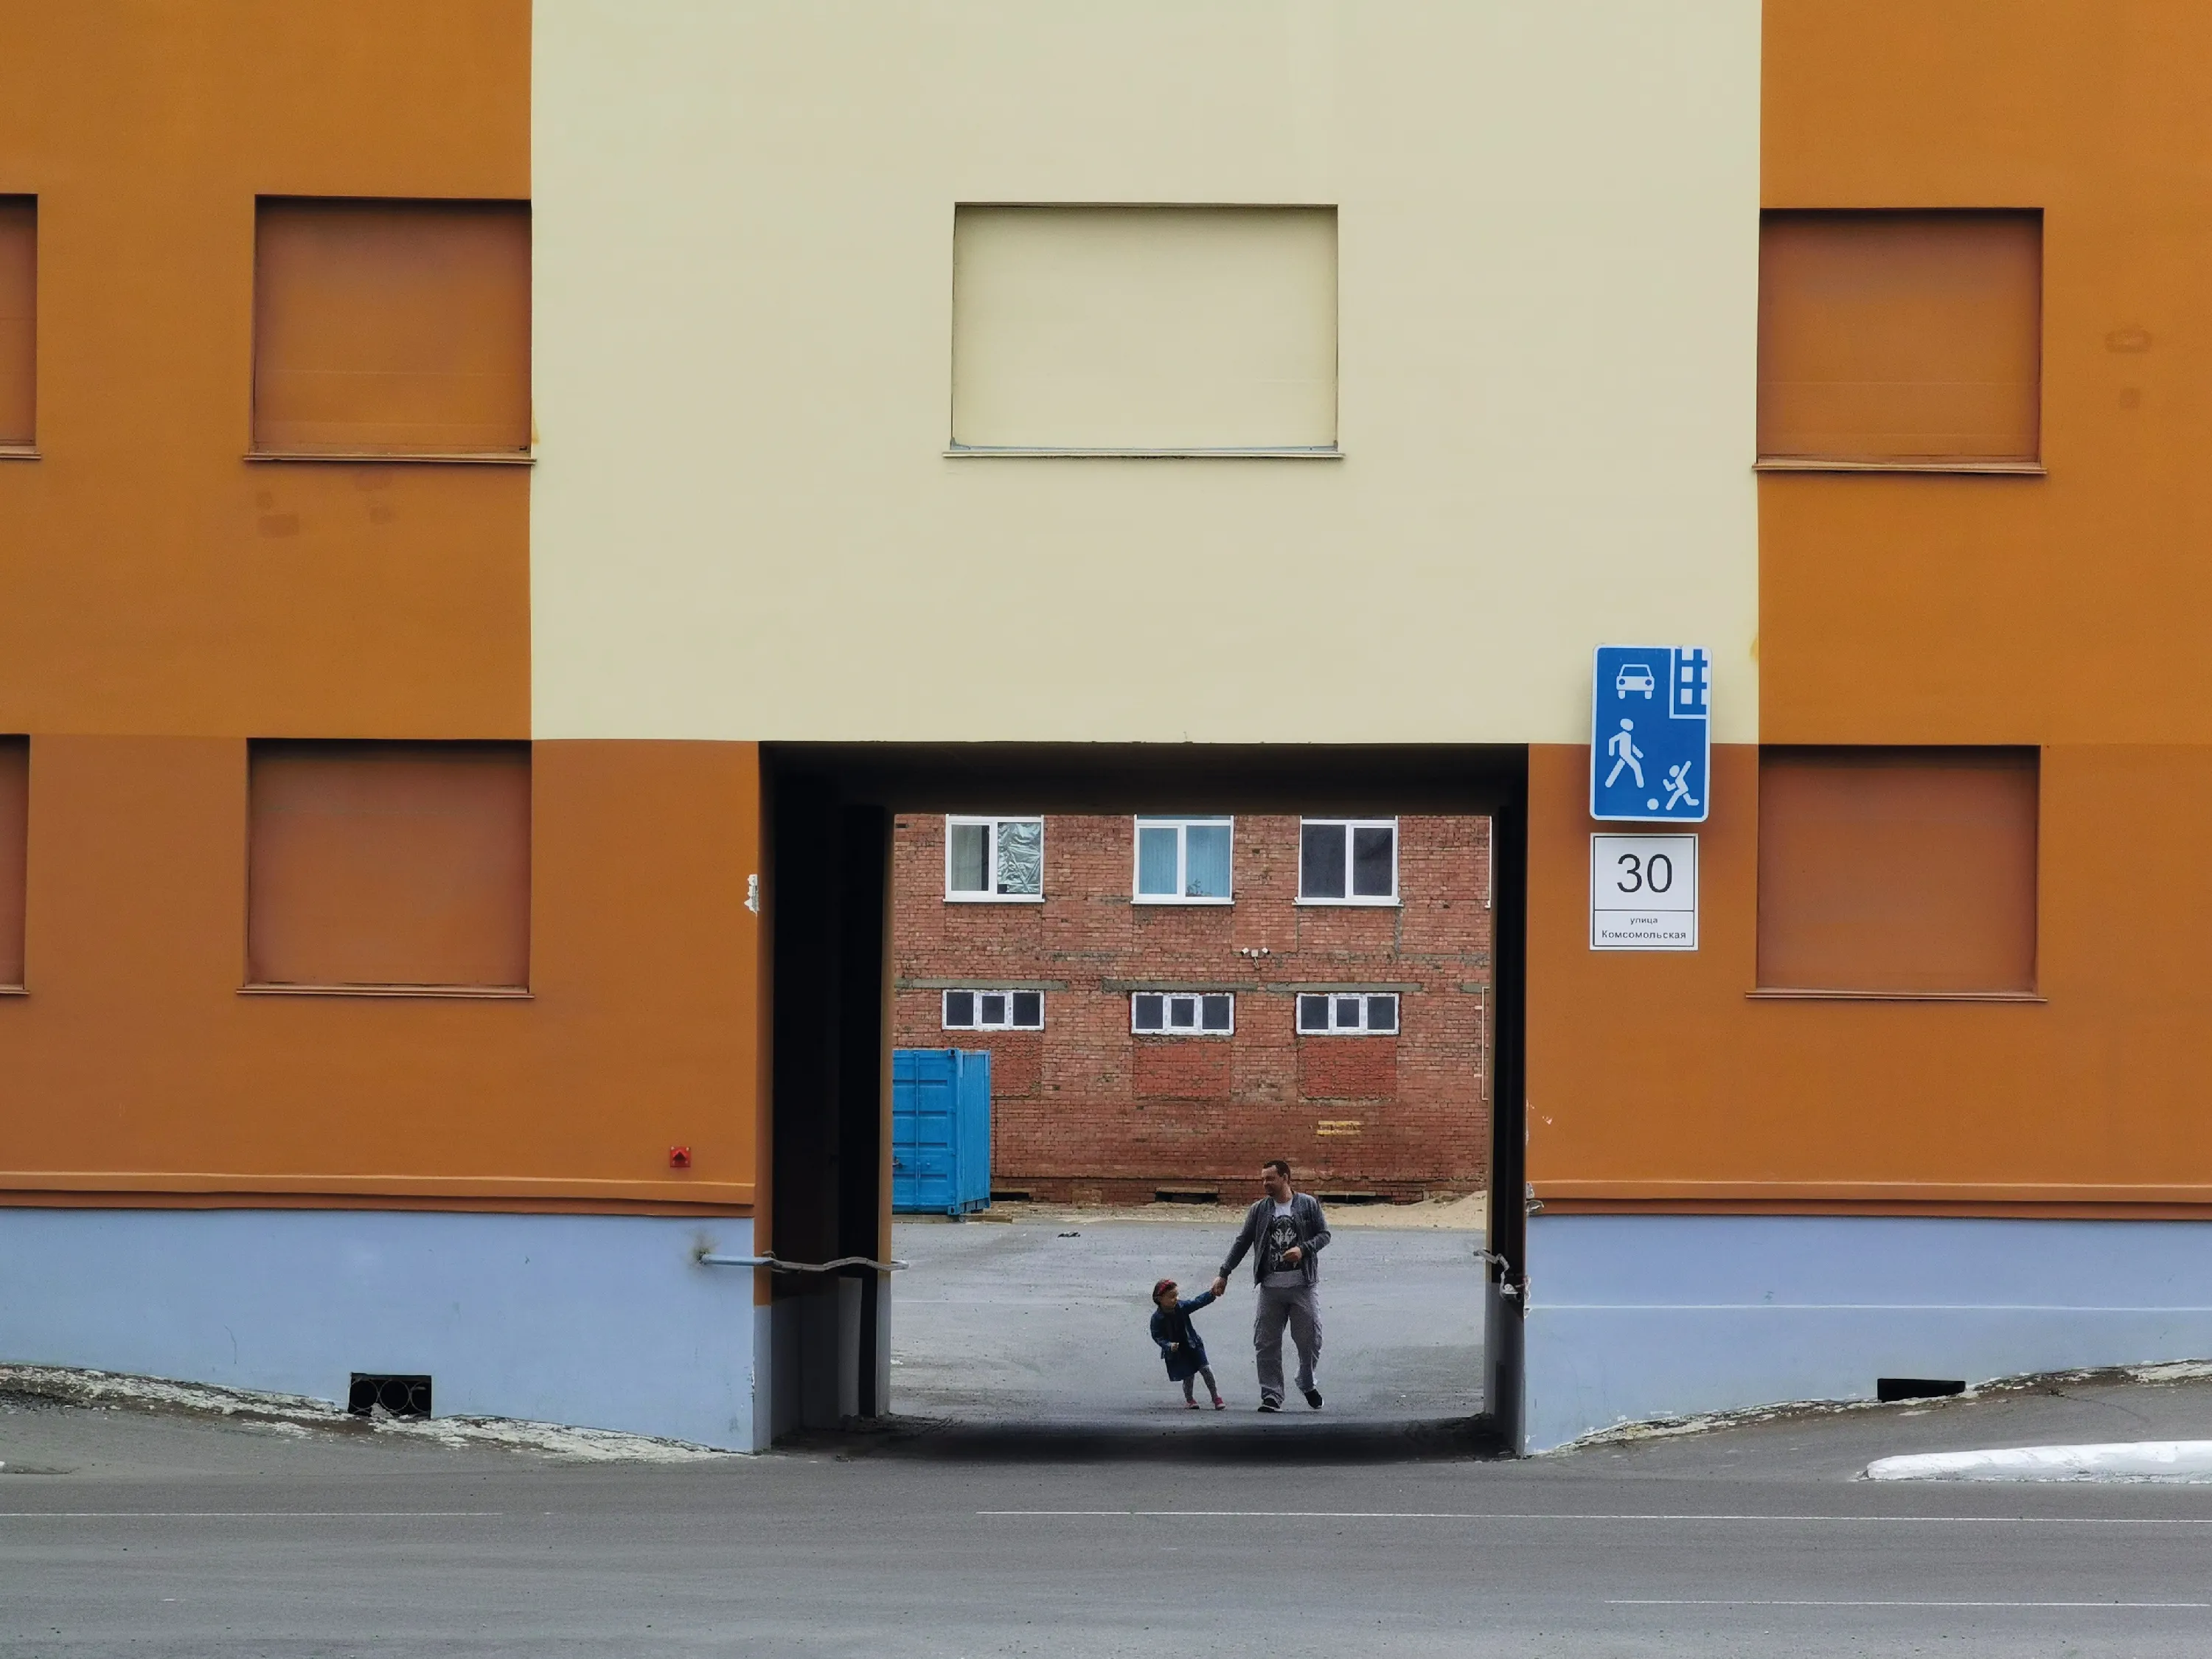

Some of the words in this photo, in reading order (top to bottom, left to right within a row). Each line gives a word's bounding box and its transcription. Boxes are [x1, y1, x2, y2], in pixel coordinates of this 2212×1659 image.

[1617, 854, 1672, 893] 30
[1630, 917, 1658, 925] улица
[1601, 930, 1686, 939] Комсомольская
